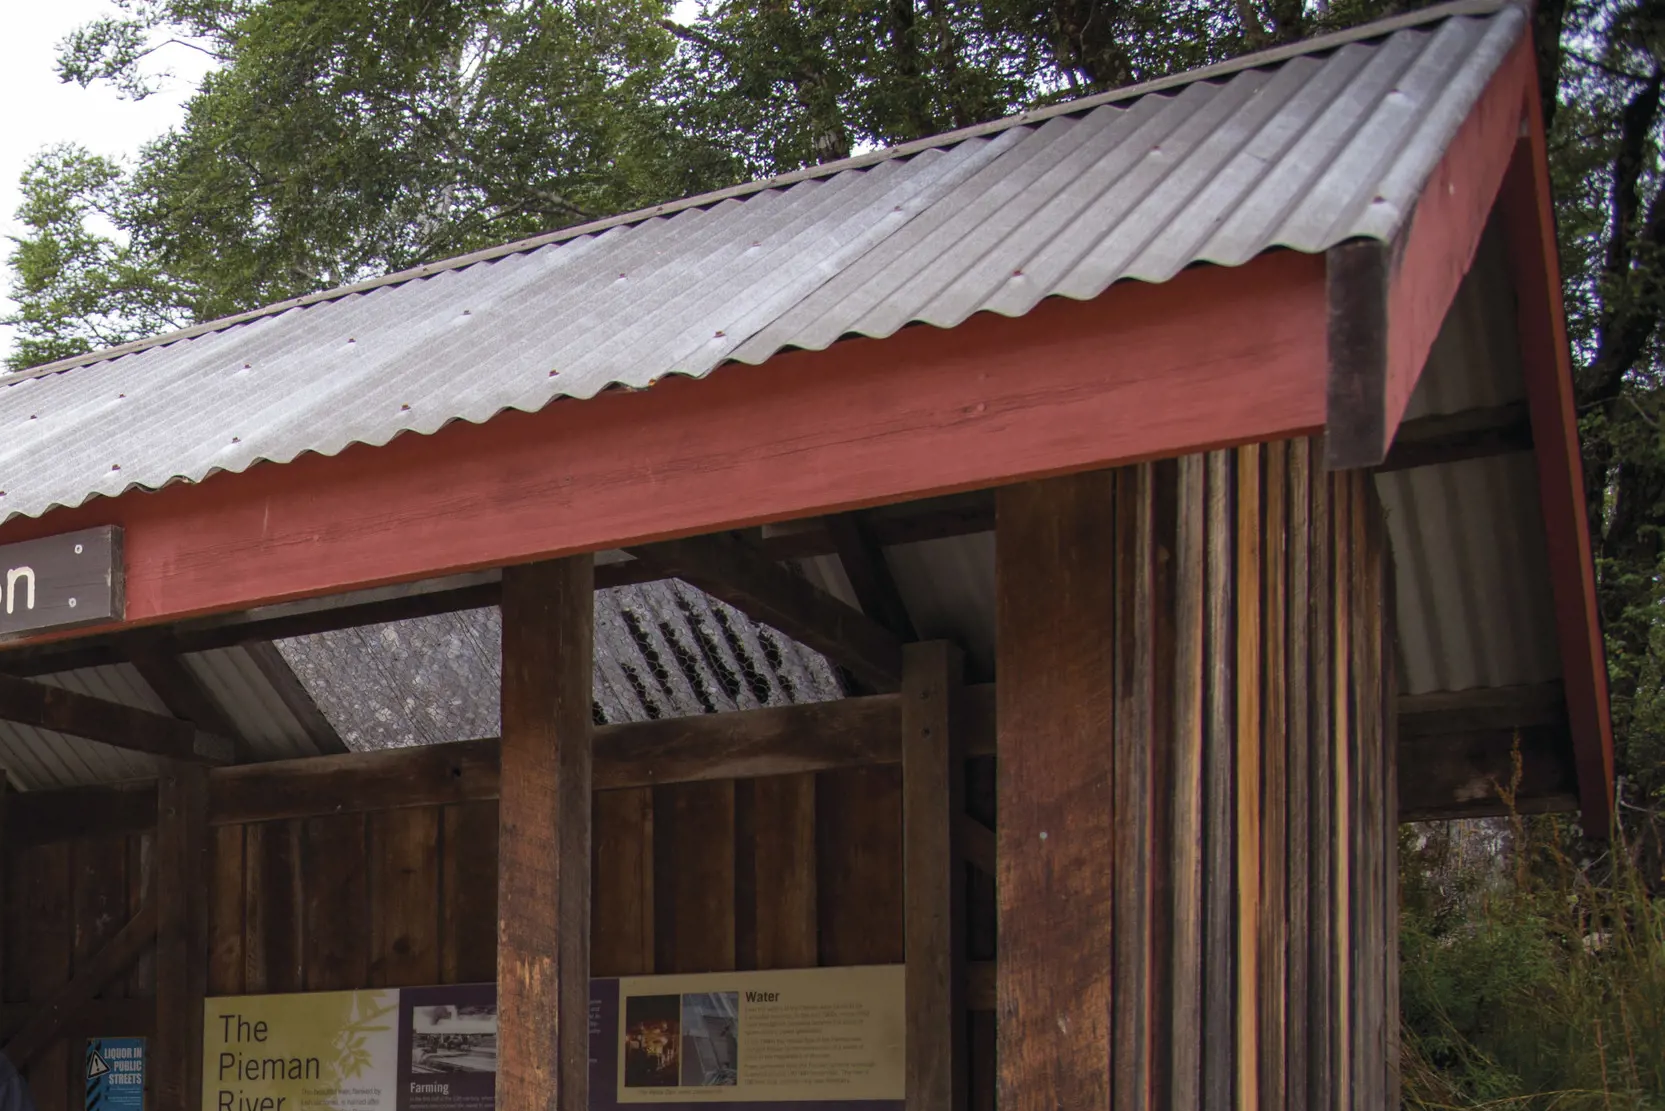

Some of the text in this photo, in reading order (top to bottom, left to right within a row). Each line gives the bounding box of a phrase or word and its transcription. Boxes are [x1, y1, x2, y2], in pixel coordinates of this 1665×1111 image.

[746, 992, 780, 1002] Water
[218, 1014, 268, 1044] The
[104, 1047, 142, 1059] LIQUOR IN
[114, 1060, 142, 1072] PUBLIC
[218, 1052, 320, 1081] Pieman
[108, 1074, 142, 1085] STREETS
[410, 1082, 449, 1095] Farming
